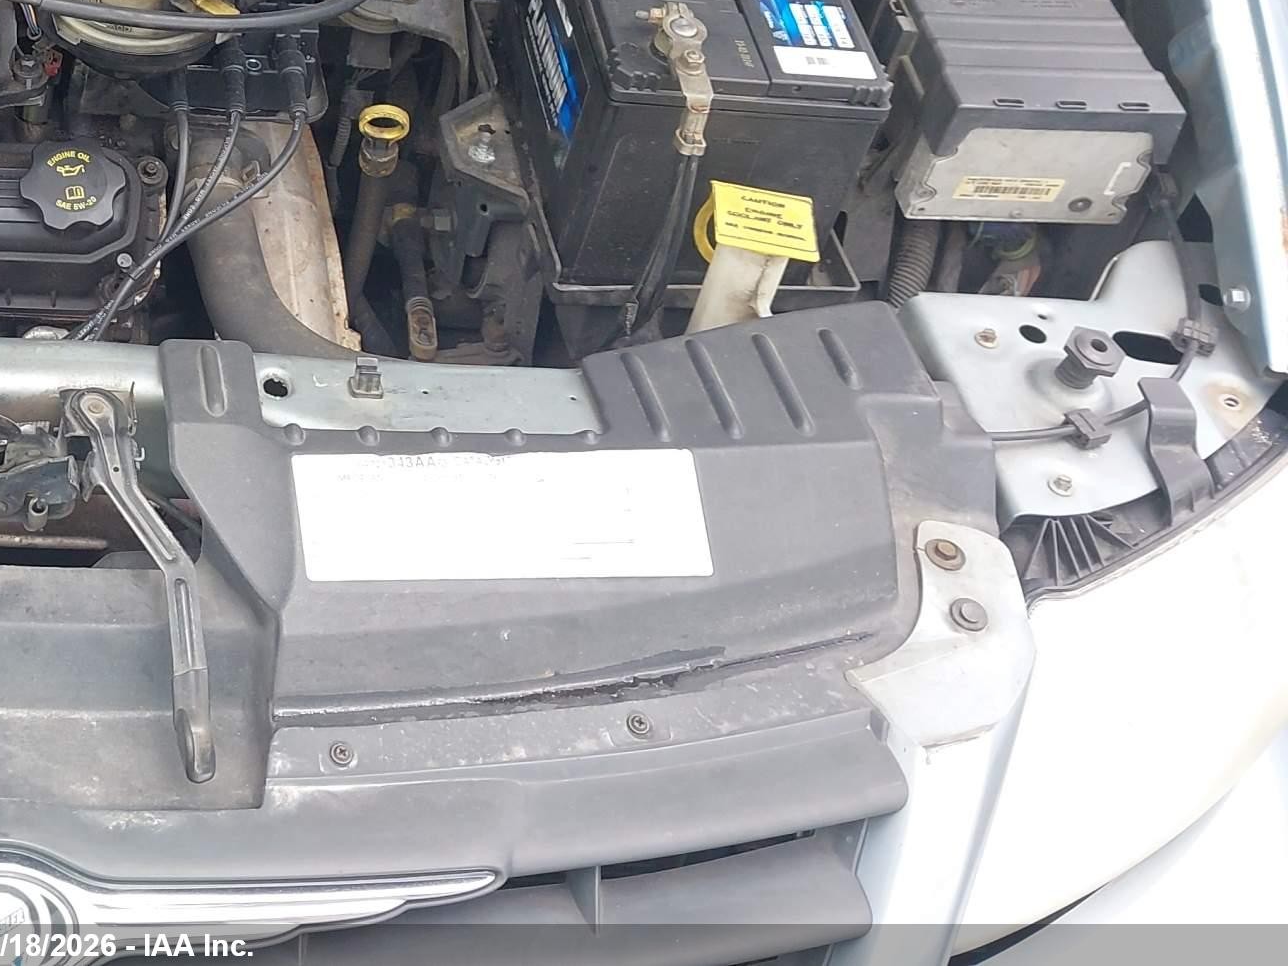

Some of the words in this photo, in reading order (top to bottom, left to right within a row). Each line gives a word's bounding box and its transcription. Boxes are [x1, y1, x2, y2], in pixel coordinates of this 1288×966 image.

[46, 150, 76, 167] ENGINE
[77, 152, 91, 163] OIL
[55, 199, 72, 210] SAE
[73, 196, 97, 210] 5W-20
[741, 196, 786, 208] CAUTION
